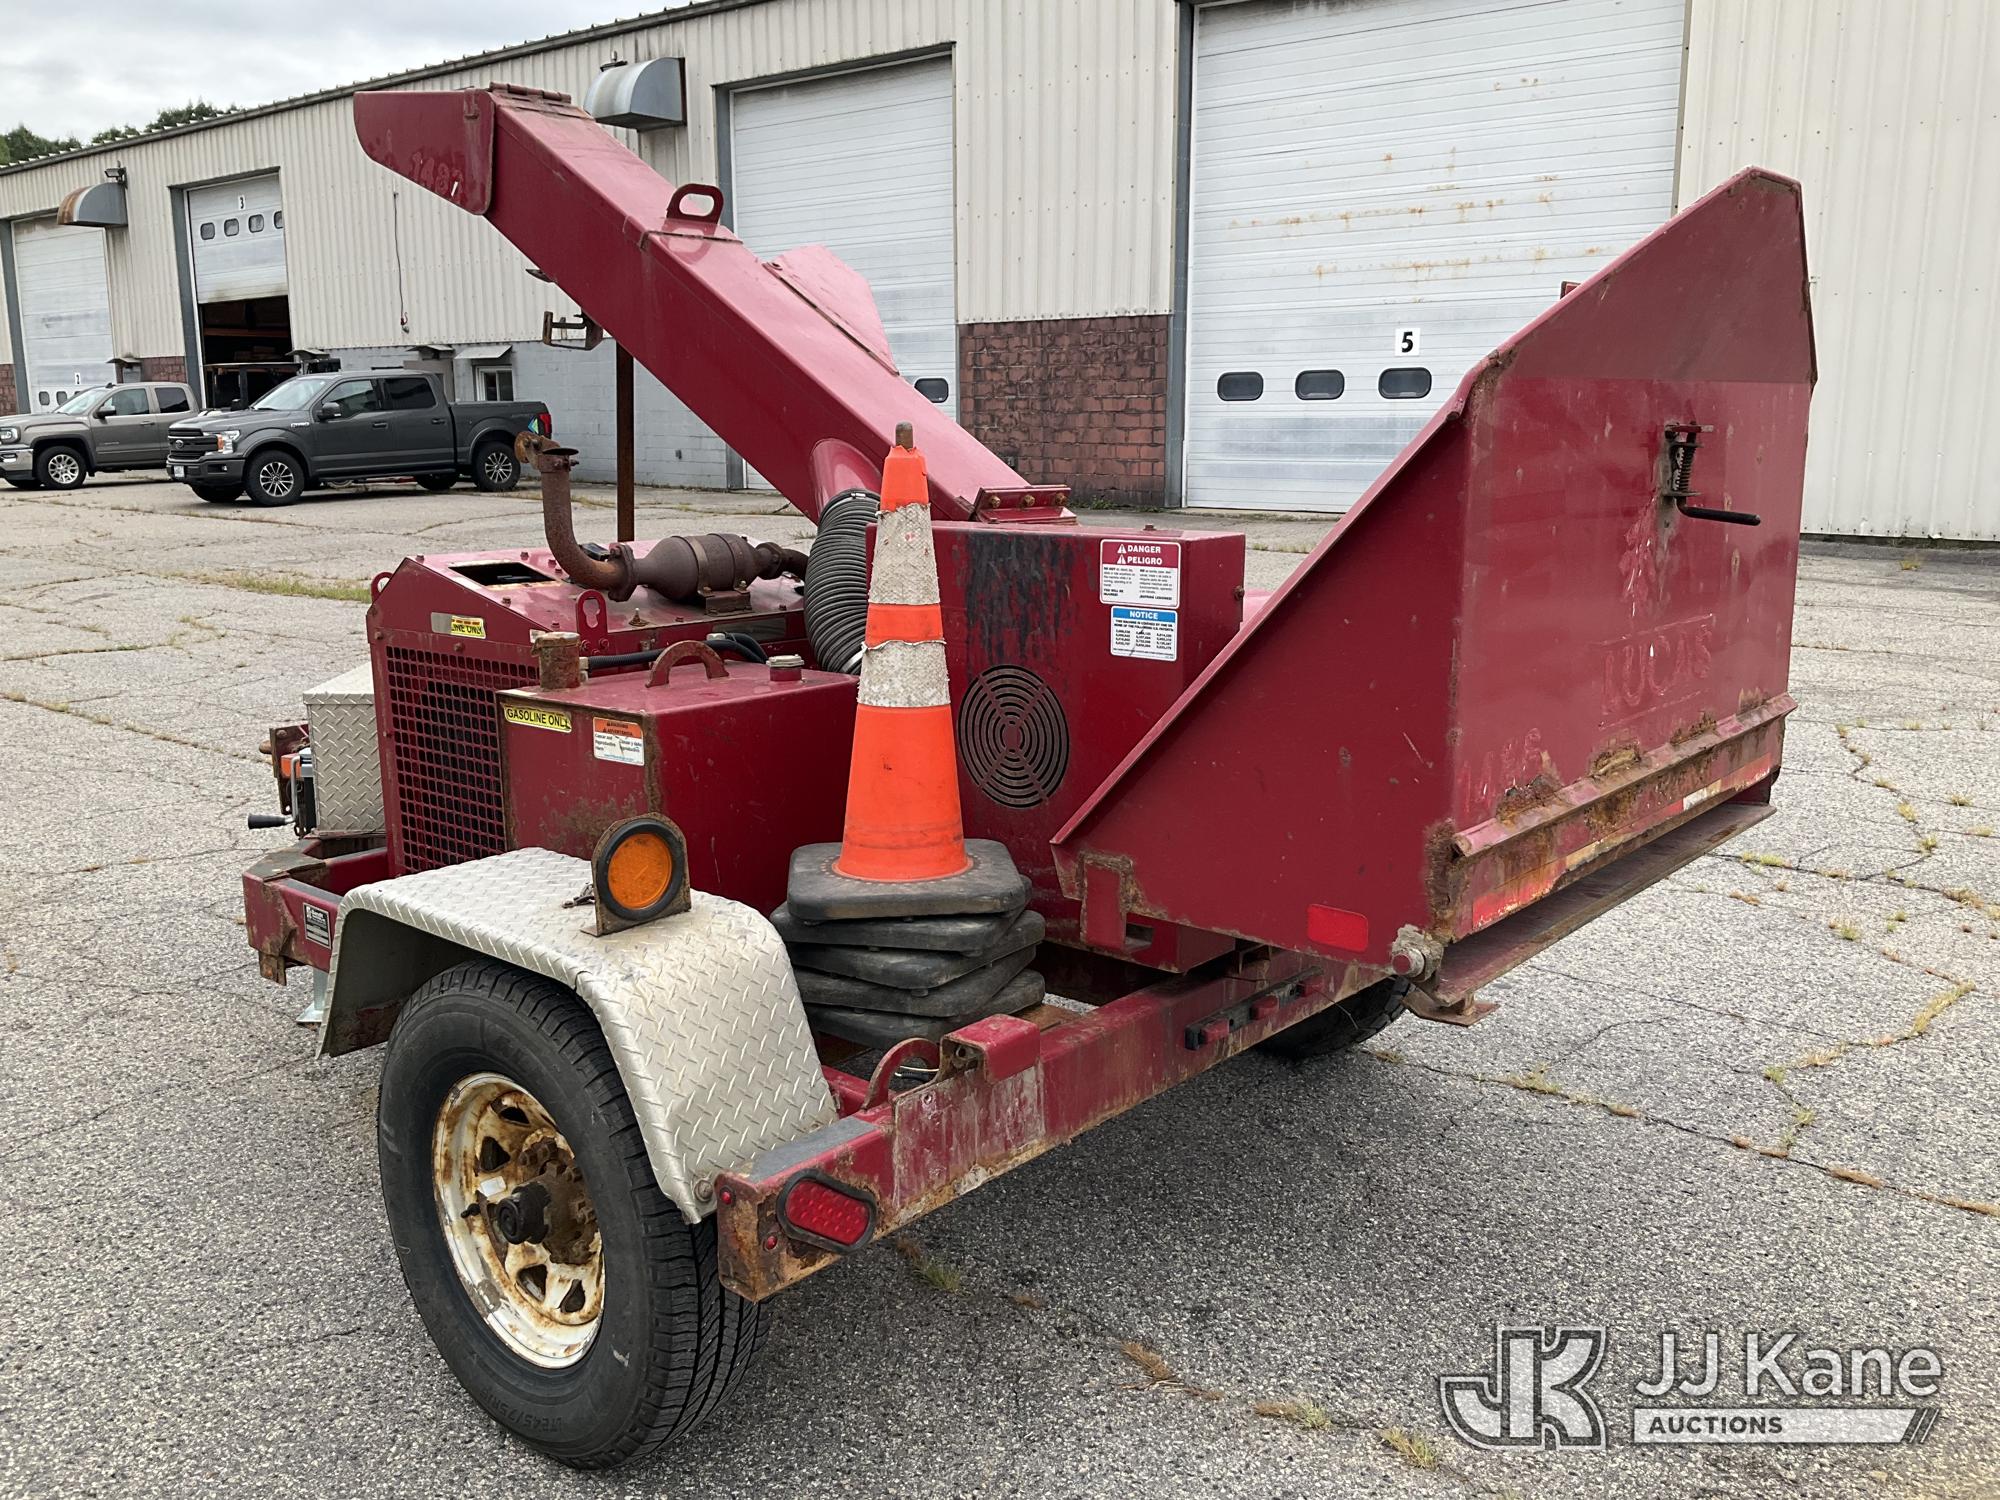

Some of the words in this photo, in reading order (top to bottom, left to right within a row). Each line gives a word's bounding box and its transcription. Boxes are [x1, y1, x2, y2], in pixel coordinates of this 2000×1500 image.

[1401, 331, 1414, 353] 5
[1127, 545, 1161, 554] DANGER
[1127, 556, 1163, 565] PELIGRO
[1129, 610, 1159, 620] NOTICE
[507, 708, 547, 724] GASOLINE
